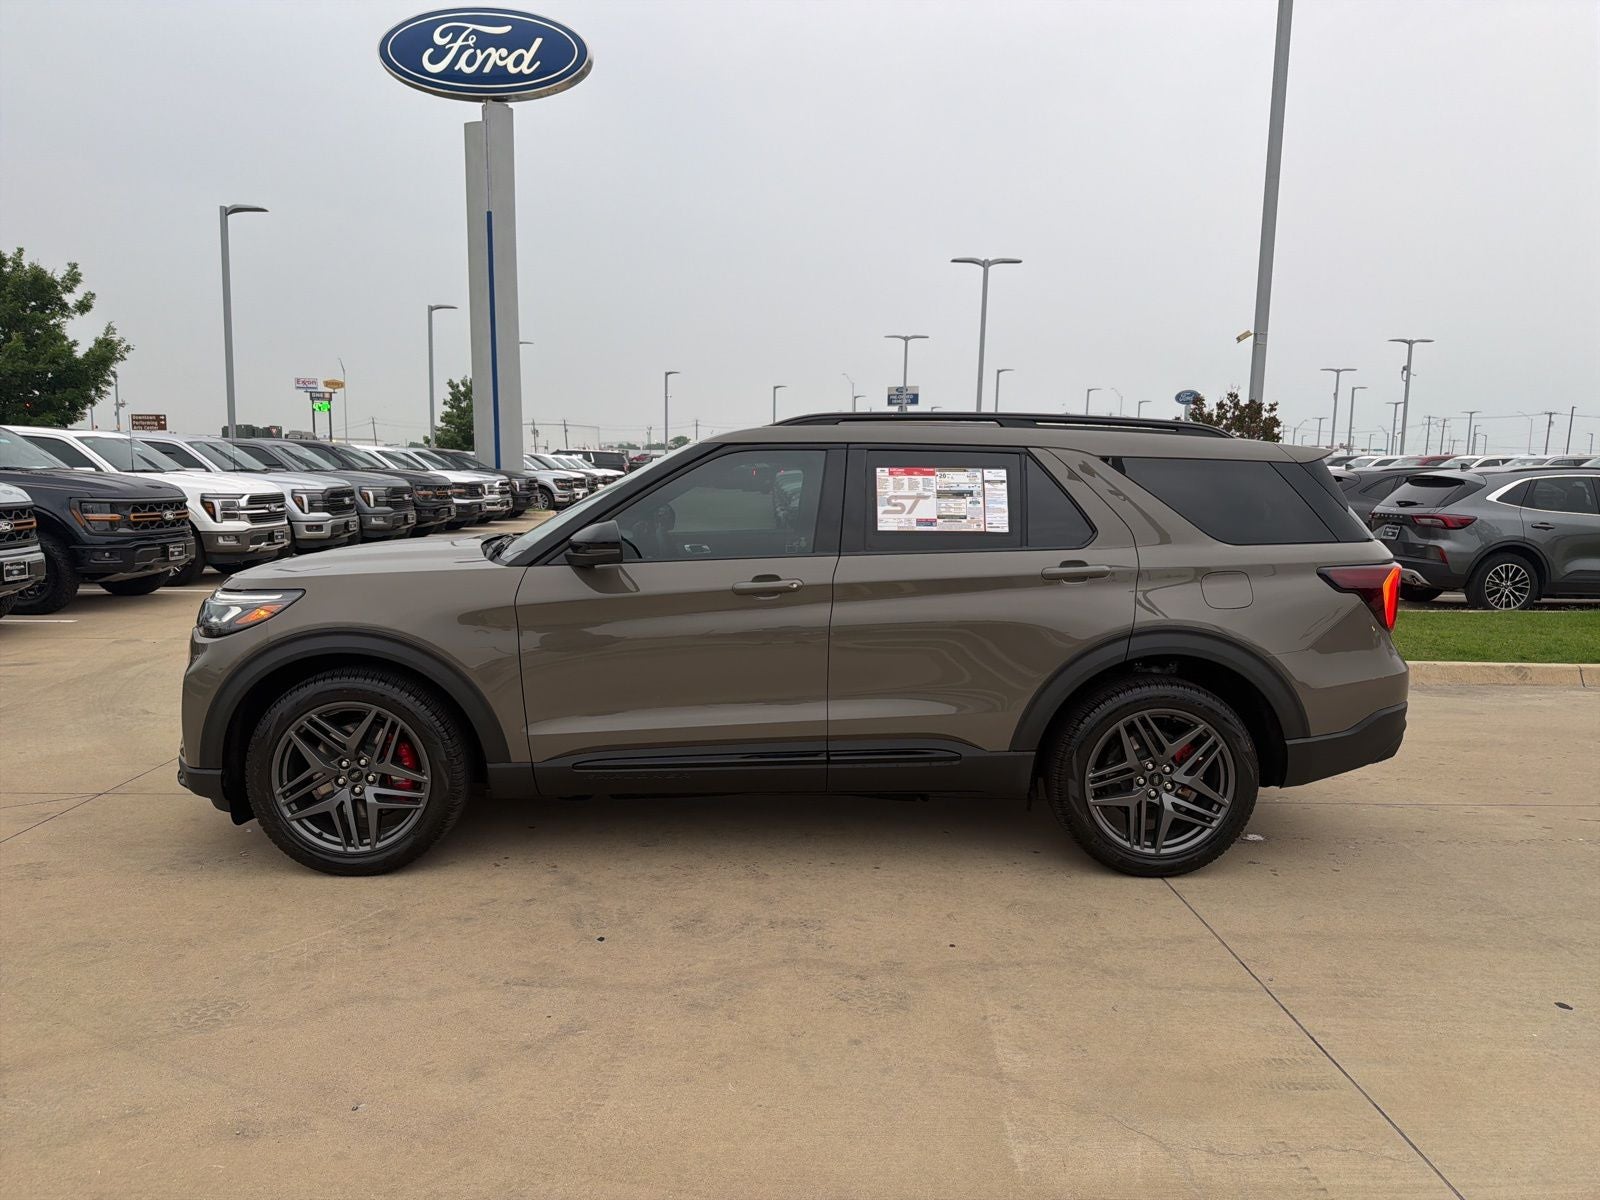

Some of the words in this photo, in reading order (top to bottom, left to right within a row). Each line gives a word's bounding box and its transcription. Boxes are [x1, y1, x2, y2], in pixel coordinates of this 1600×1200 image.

[421, 22, 543, 75] Ford
[296, 378, 317, 387] Exxon
[881, 495, 931, 514] ST
